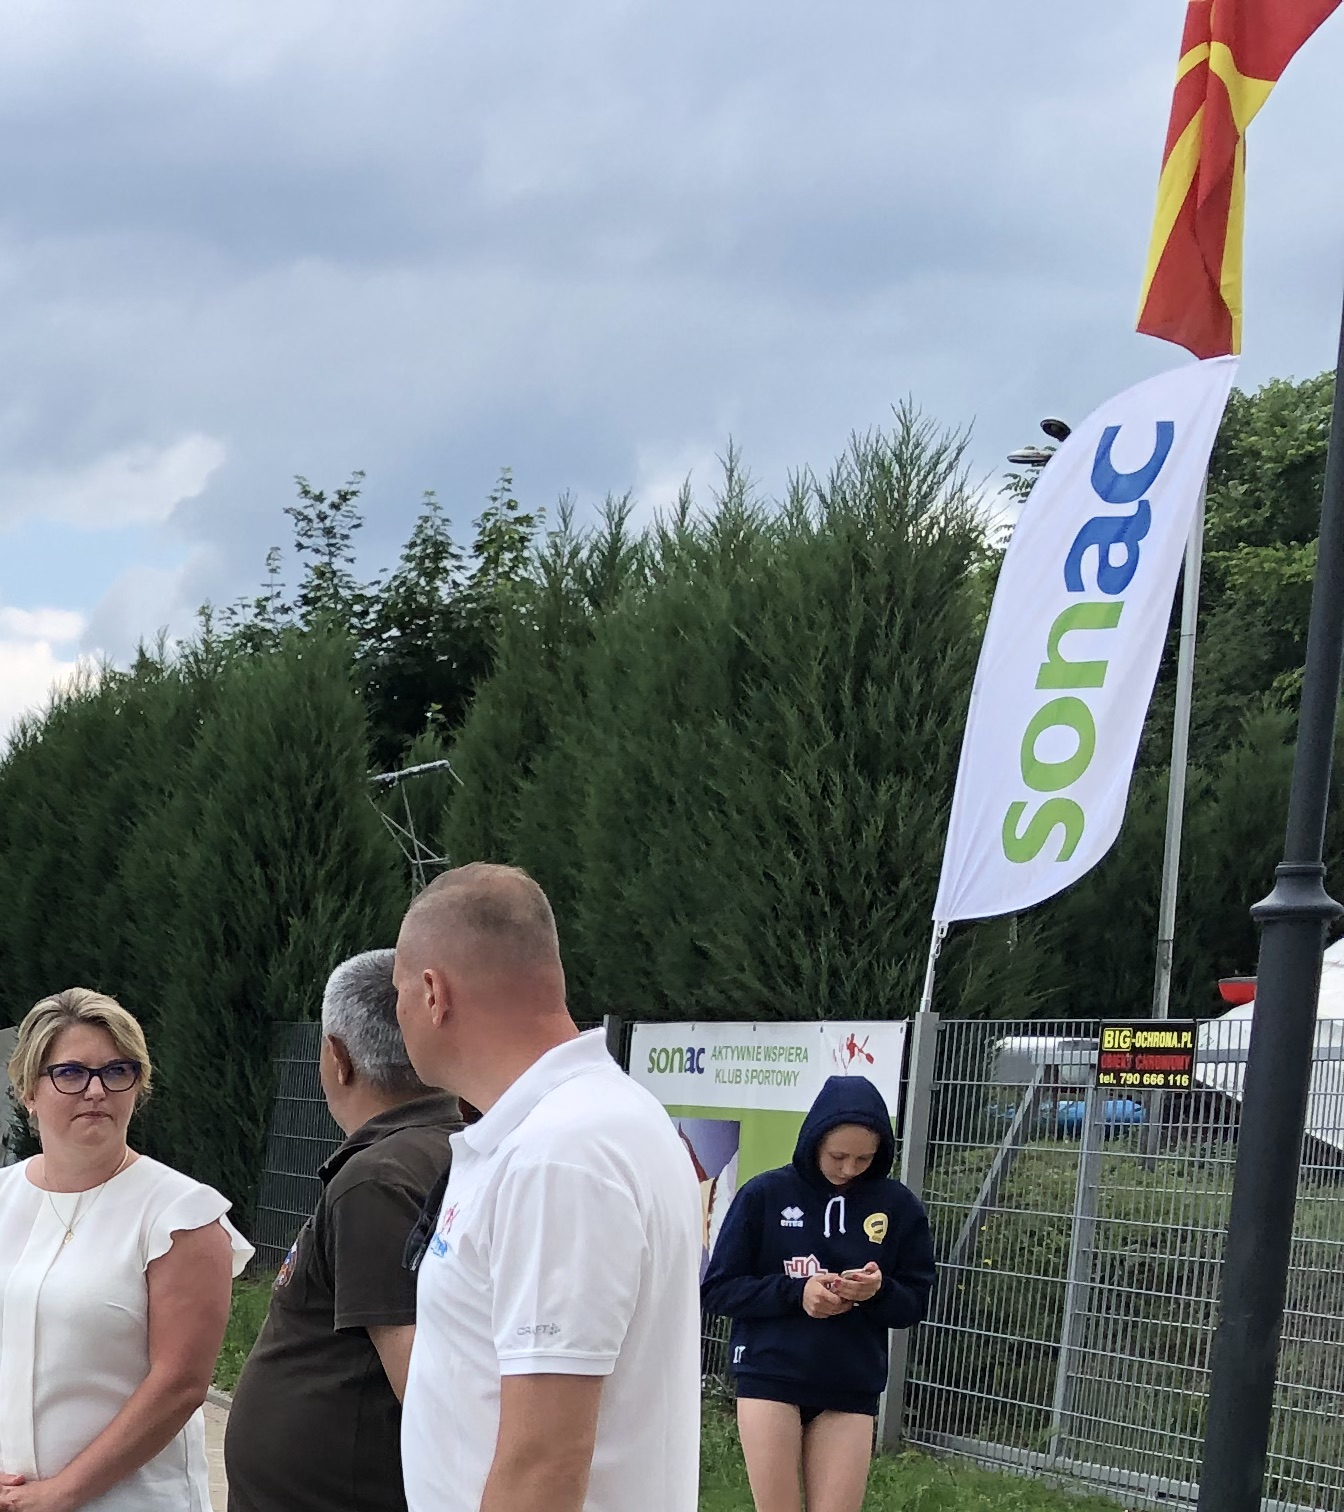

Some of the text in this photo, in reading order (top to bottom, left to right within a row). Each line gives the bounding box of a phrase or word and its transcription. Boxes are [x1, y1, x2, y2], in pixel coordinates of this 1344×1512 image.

[1002, 420, 1174, 864] sonac
[647, 1046, 706, 1075] sonac
[711, 1044, 809, 1064] AKTYWNIE WSPIERA
[714, 1068, 801, 1087] KLUB SPORTOWY
[1099, 1072, 1190, 1087] tel. 790 666 116
